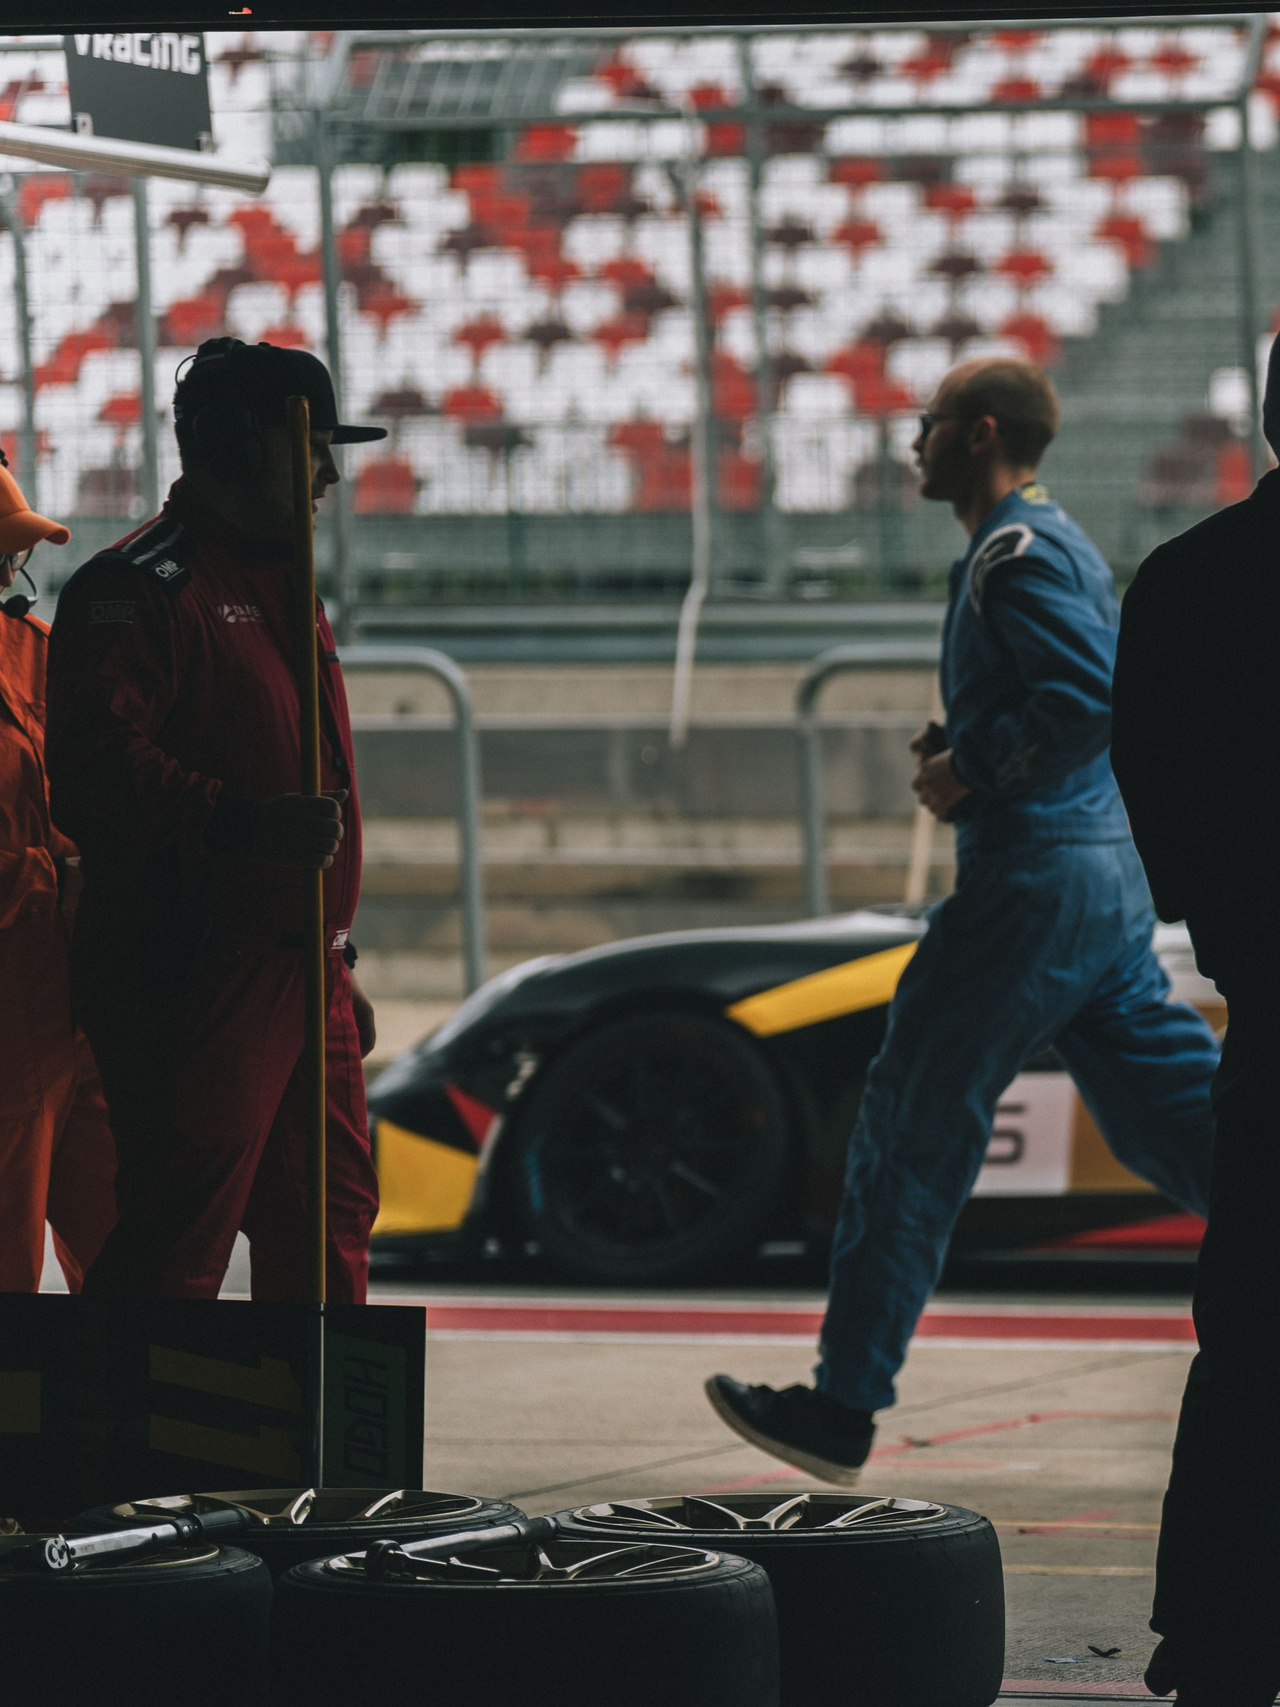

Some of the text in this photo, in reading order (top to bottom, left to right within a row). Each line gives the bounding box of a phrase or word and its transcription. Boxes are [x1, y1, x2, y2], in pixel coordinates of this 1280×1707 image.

[155, 560, 180, 579] OMP
[91, 604, 135, 620] OMP
[75, 1387, 107, 1507] STOP
[149, 1344, 302, 1483] 11
